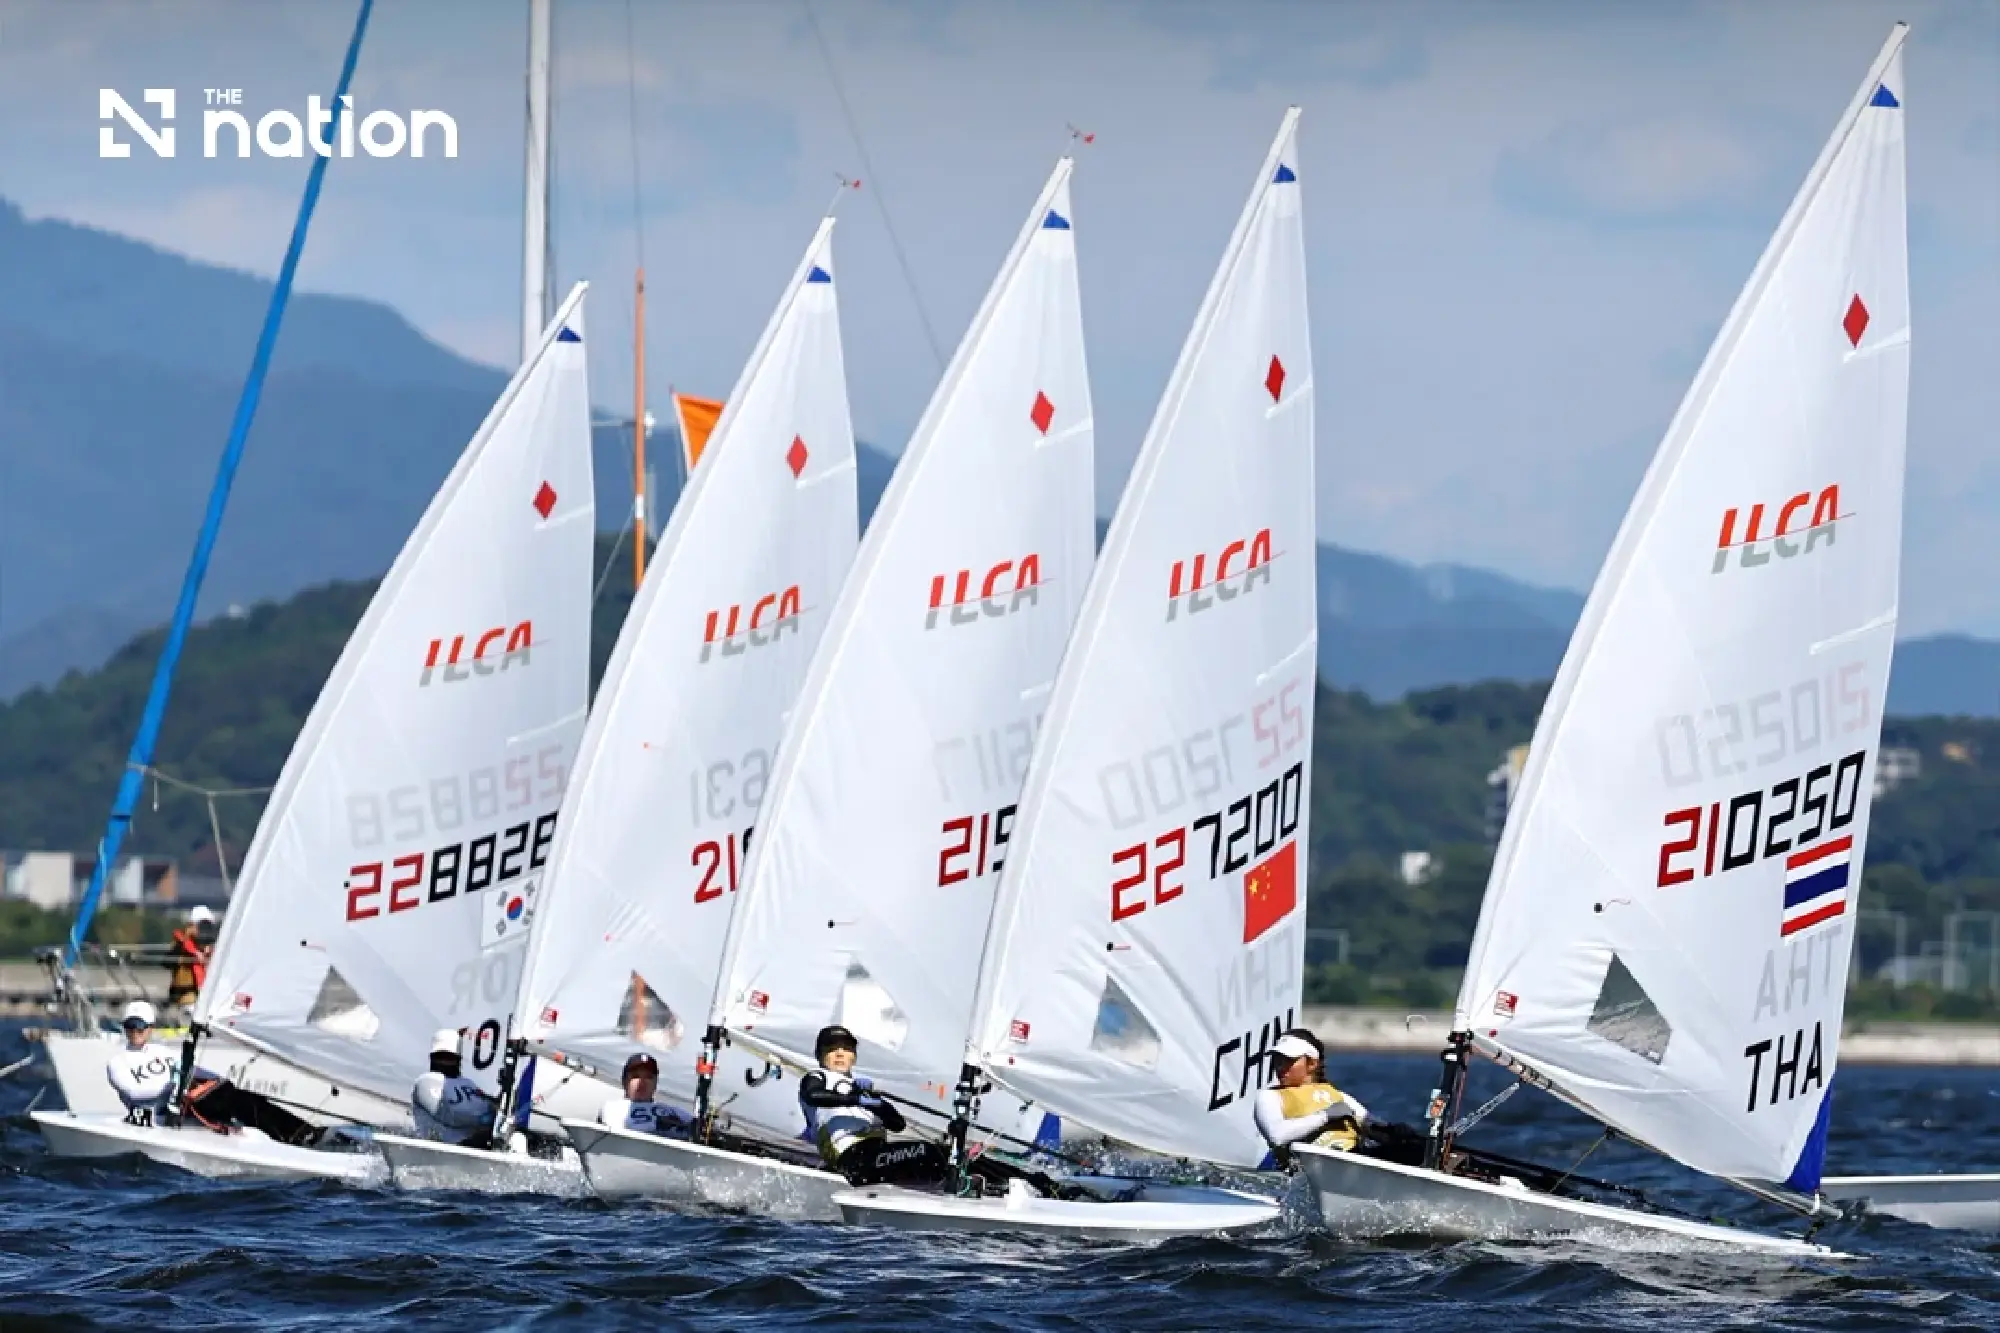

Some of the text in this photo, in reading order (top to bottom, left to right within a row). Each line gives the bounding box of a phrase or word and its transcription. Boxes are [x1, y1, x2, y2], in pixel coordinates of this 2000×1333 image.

[1712, 484, 1841, 574] ILCA
[925, 554, 1041, 629] ILCA
[1166, 528, 1272, 622] ILCA
[419, 620, 533, 687] ILCA
[699, 584, 799, 663] ILCA
[1111, 761, 1303, 922] 227200
[1657, 750, 1866, 888] 210250
[691, 824, 755, 903] 21
[1745, 1020, 1822, 1113] THA
[875, 1143, 926, 1167] CHINA
